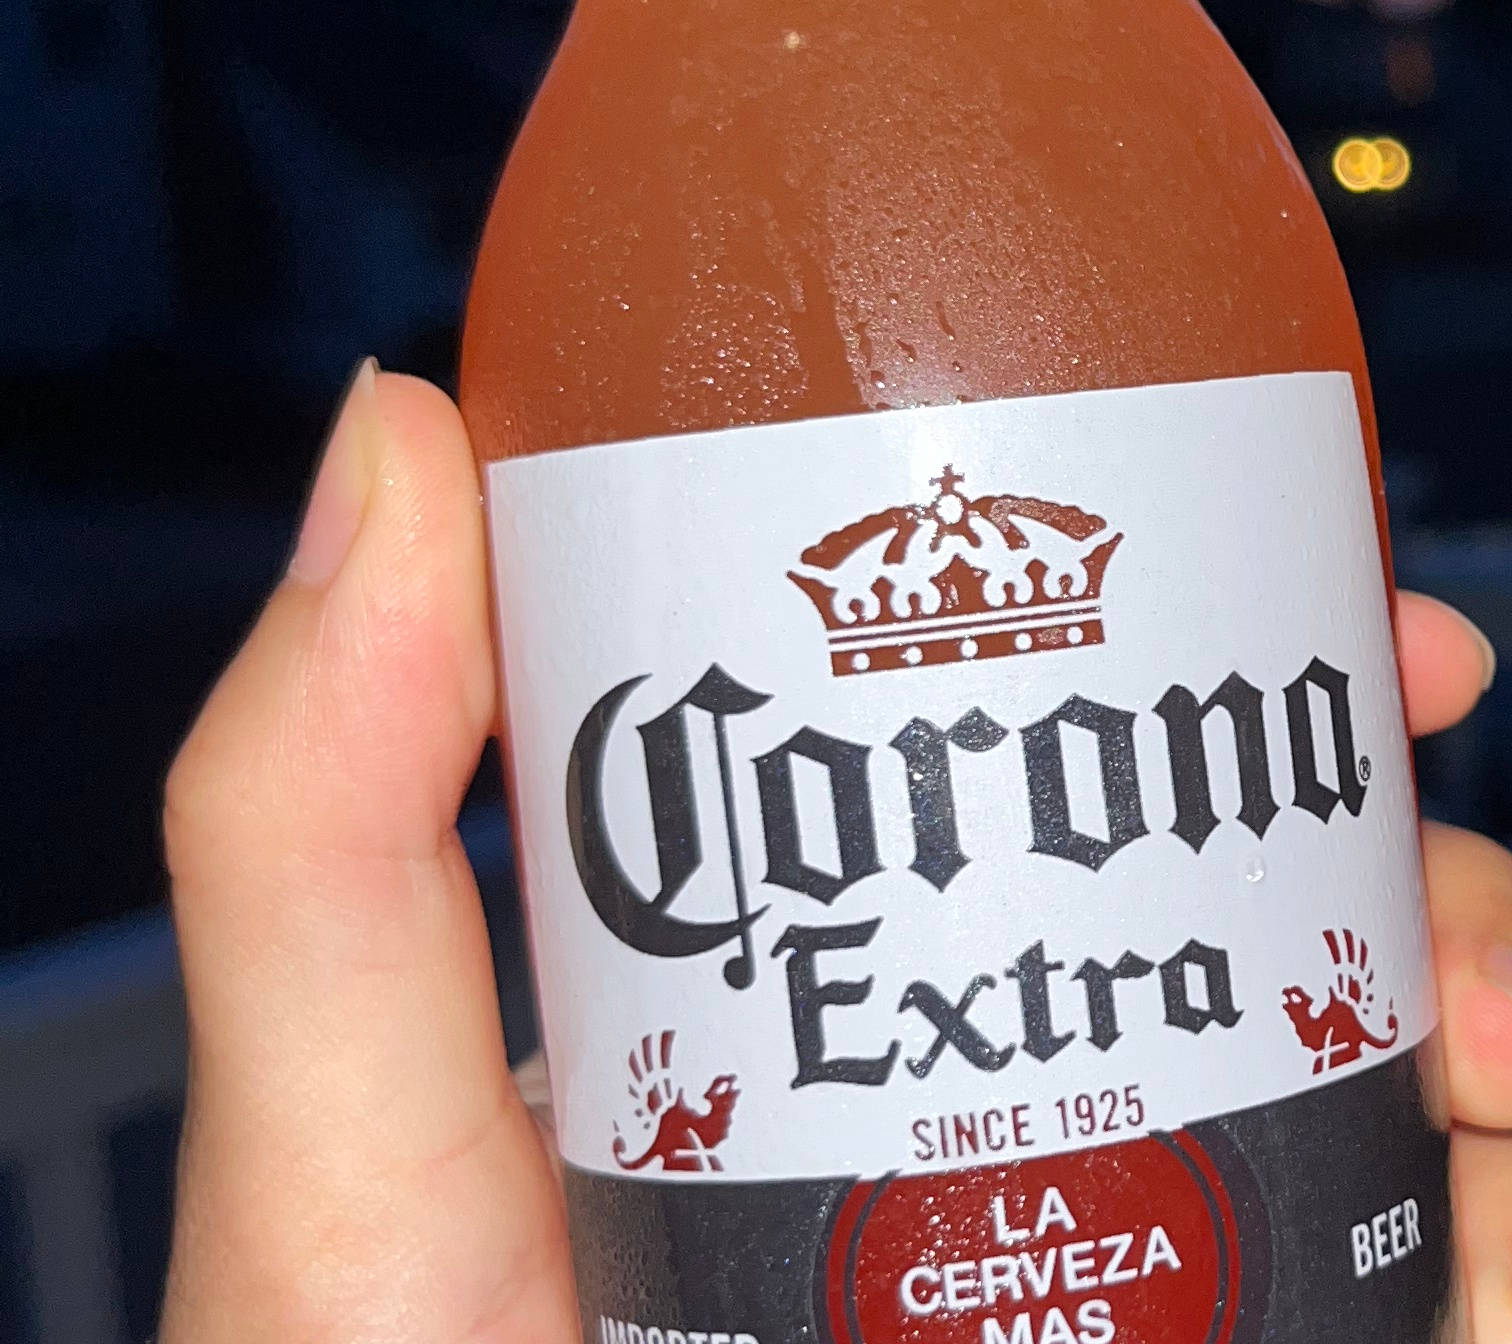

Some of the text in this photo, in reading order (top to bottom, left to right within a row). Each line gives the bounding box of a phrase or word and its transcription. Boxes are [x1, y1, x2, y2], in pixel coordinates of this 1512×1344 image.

[565, 655, 1368, 990] Corona
[770, 916, 1244, 1090] Extra
[912, 1084, 1146, 1162] SINCE 1925
[993, 1185, 1077, 1246] LA
[1350, 1197, 1422, 1279] BEER
[899, 1226, 1182, 1317] CERVEZA
